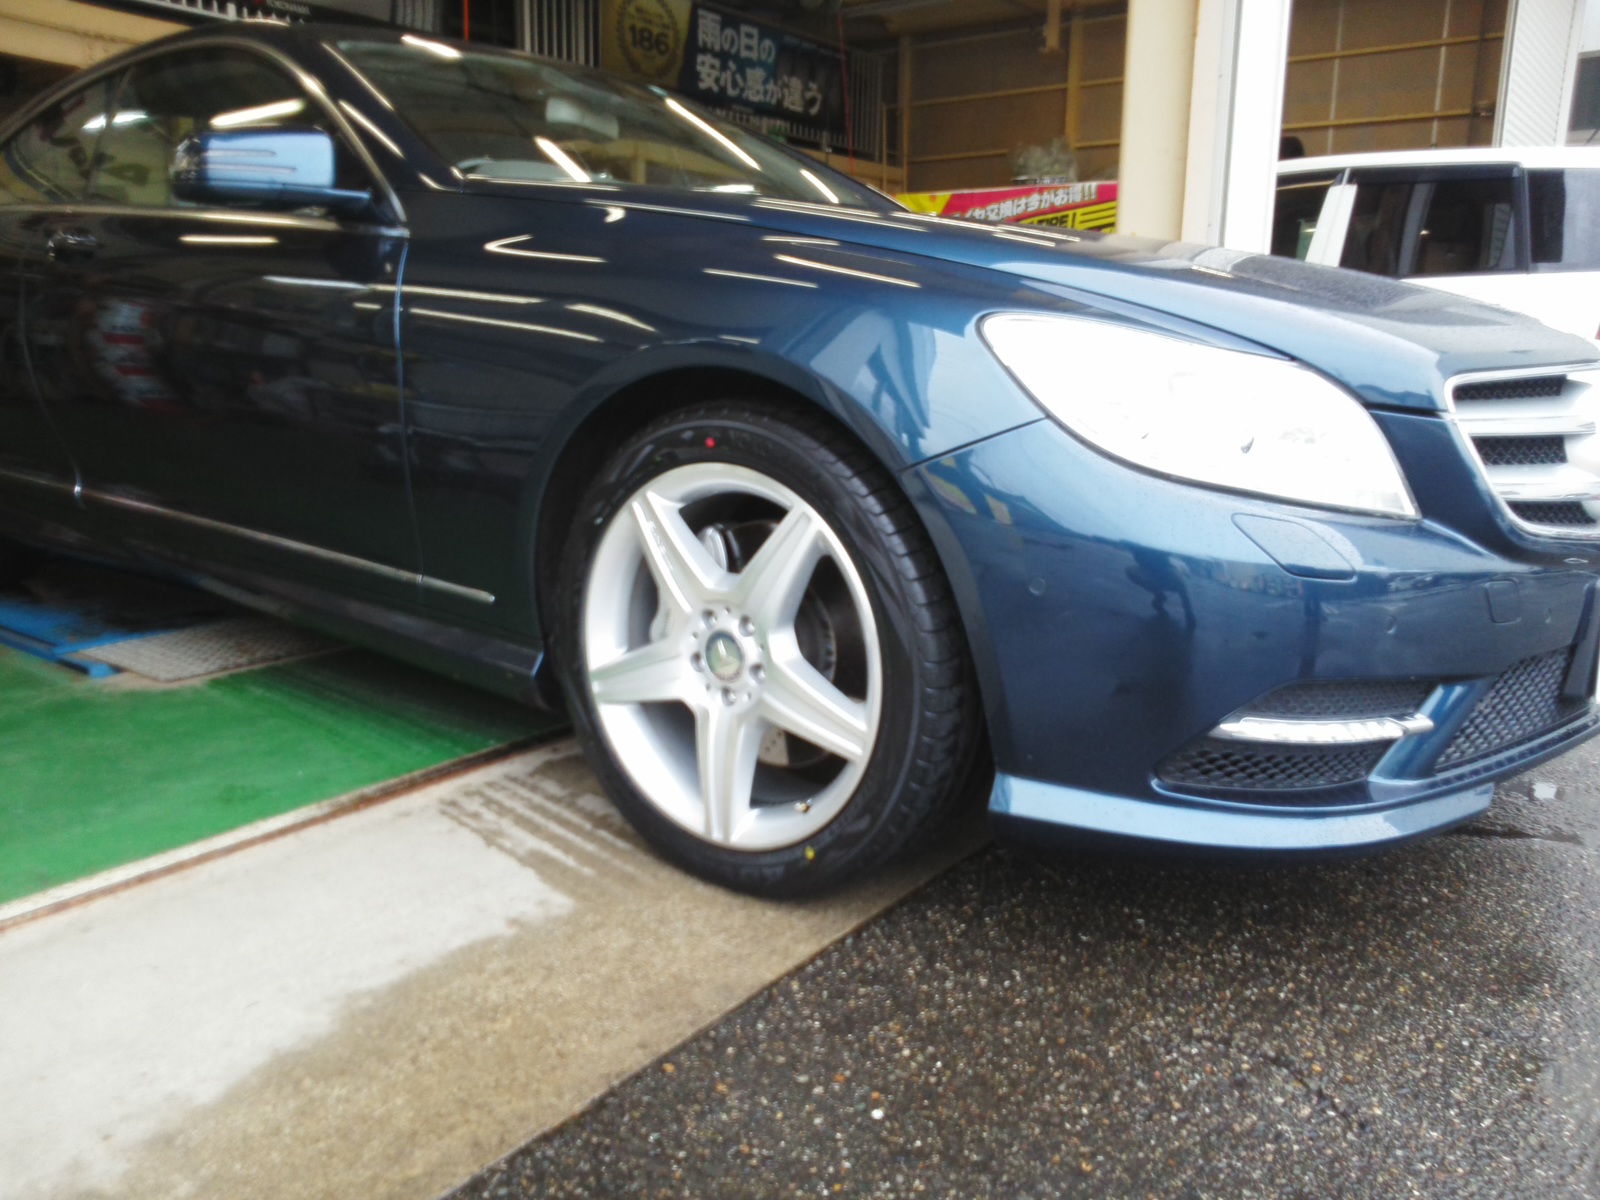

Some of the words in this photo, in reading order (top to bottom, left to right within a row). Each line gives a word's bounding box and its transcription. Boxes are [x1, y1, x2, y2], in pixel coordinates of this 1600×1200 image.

[629, 23, 669, 55] 186
[696, 8, 776, 63] 雨の日の
[695, 53, 822, 116] 安心感が違う
